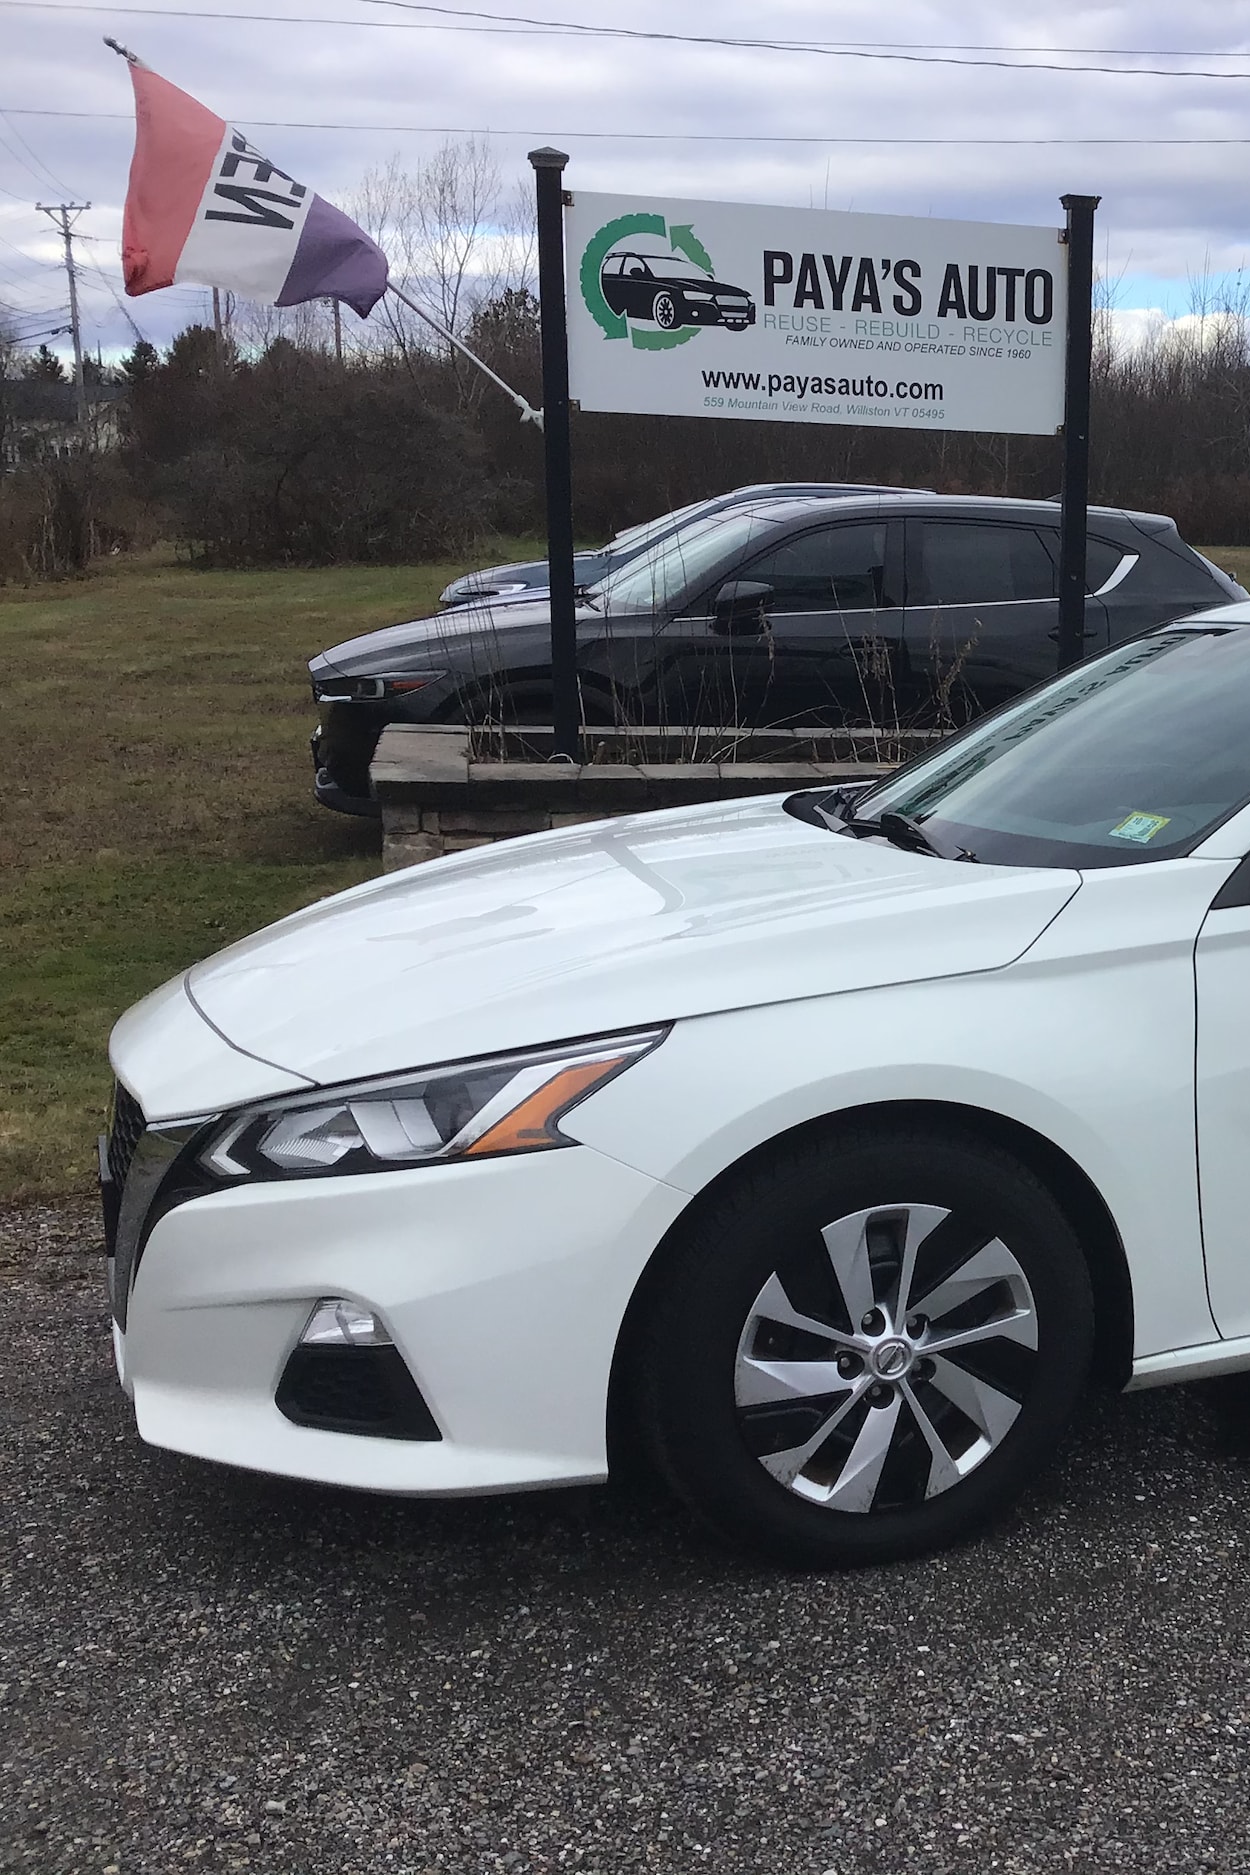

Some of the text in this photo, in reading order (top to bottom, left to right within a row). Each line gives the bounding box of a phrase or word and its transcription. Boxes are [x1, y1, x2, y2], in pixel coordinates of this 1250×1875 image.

[763, 250, 1053, 325] PAYA'S AUTO
[764, 313, 831, 333] REUSE
[855, 319, 940, 339] REBUILD
[963, 326, 1052, 347] RECYCLE
[785, 335, 1031, 360] FAMILY OWNED AND OPERATED SINCE 1960
[701, 370, 944, 400] www.payasauto.com
[703, 396, 724, 408] 559
[727, 398, 778, 411] Mountain
[782, 401, 808, 412] View
[846, 404, 890, 417] Williston
[894, 407, 910, 417] VT
[911, 408, 945, 419] 05495
